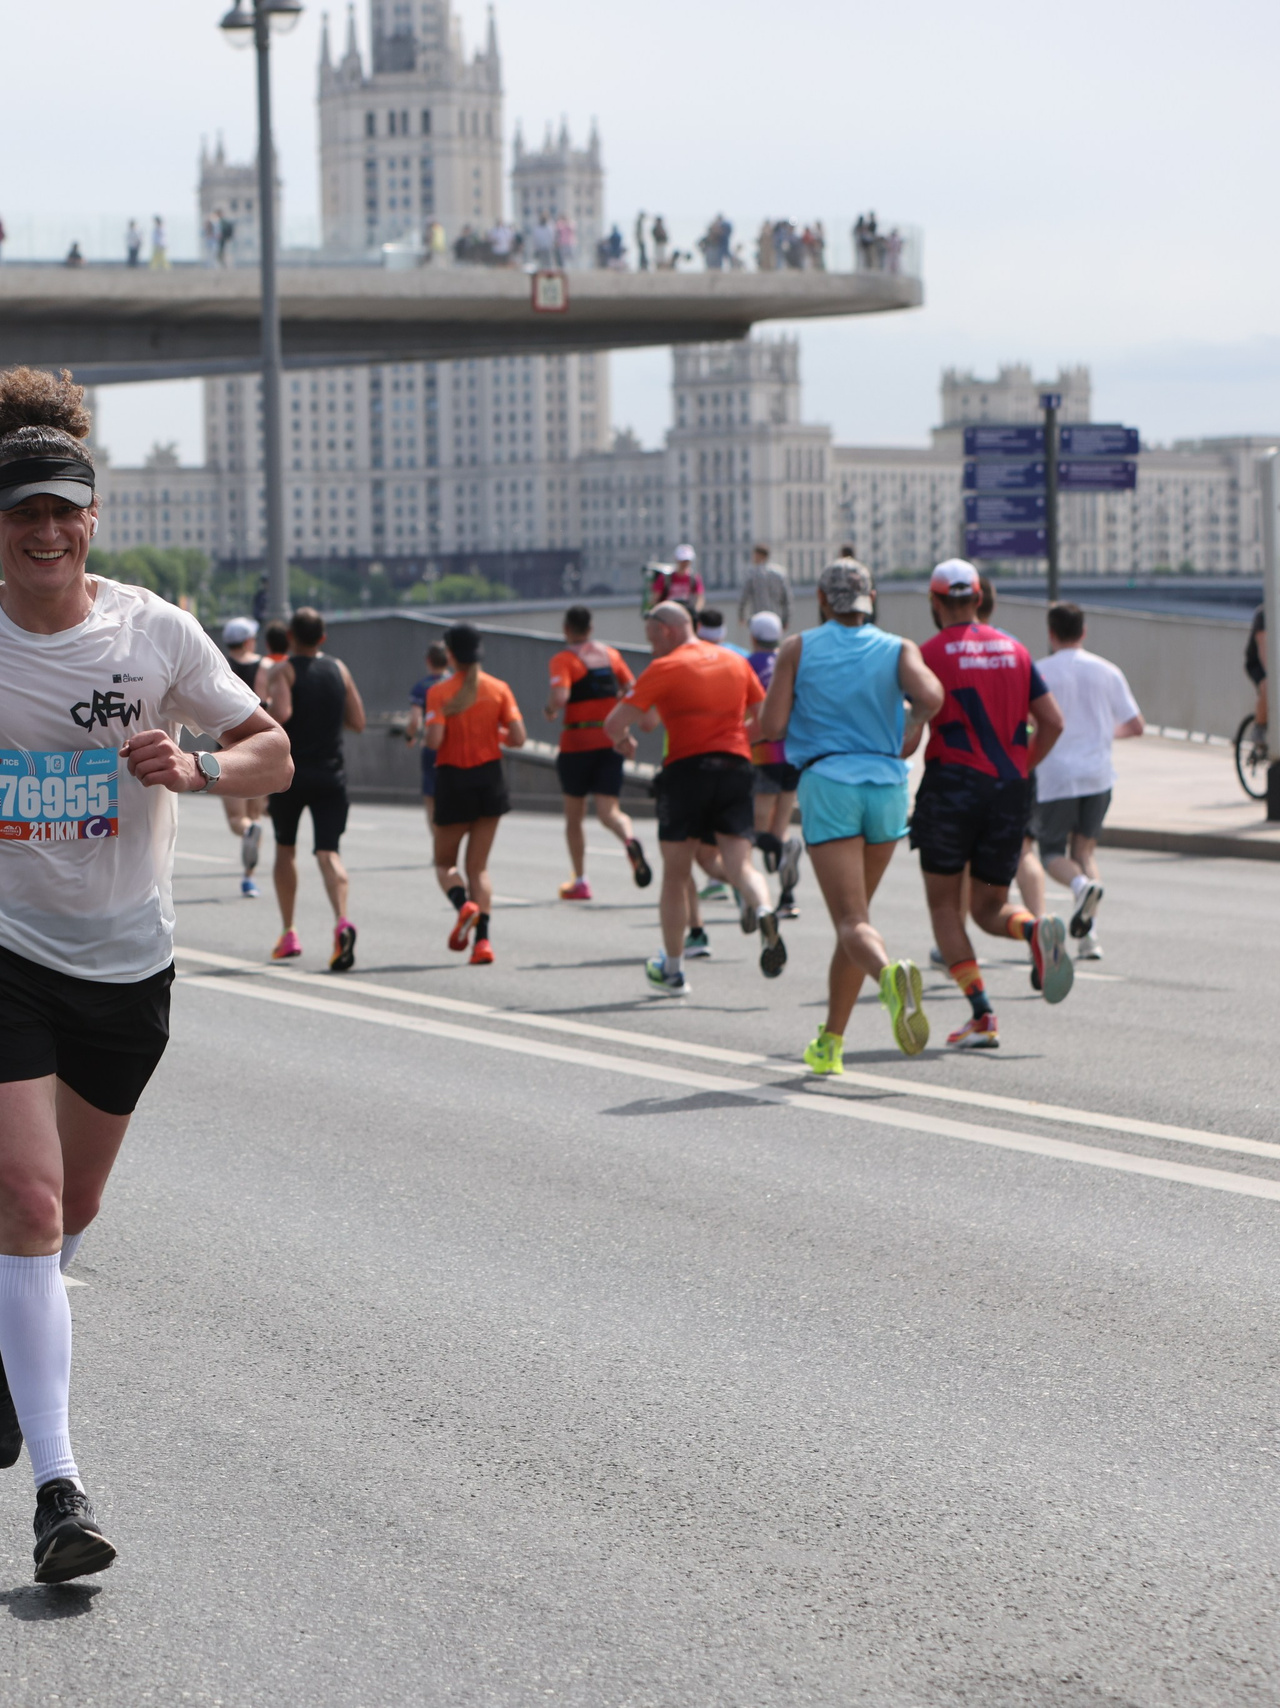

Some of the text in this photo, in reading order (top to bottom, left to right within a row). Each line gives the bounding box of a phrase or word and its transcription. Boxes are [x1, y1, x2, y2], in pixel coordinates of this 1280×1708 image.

[70, 689, 141, 733] CREW
[3, 759, 19, 767] ПСБ
[43, 755, 65, 774] 10
